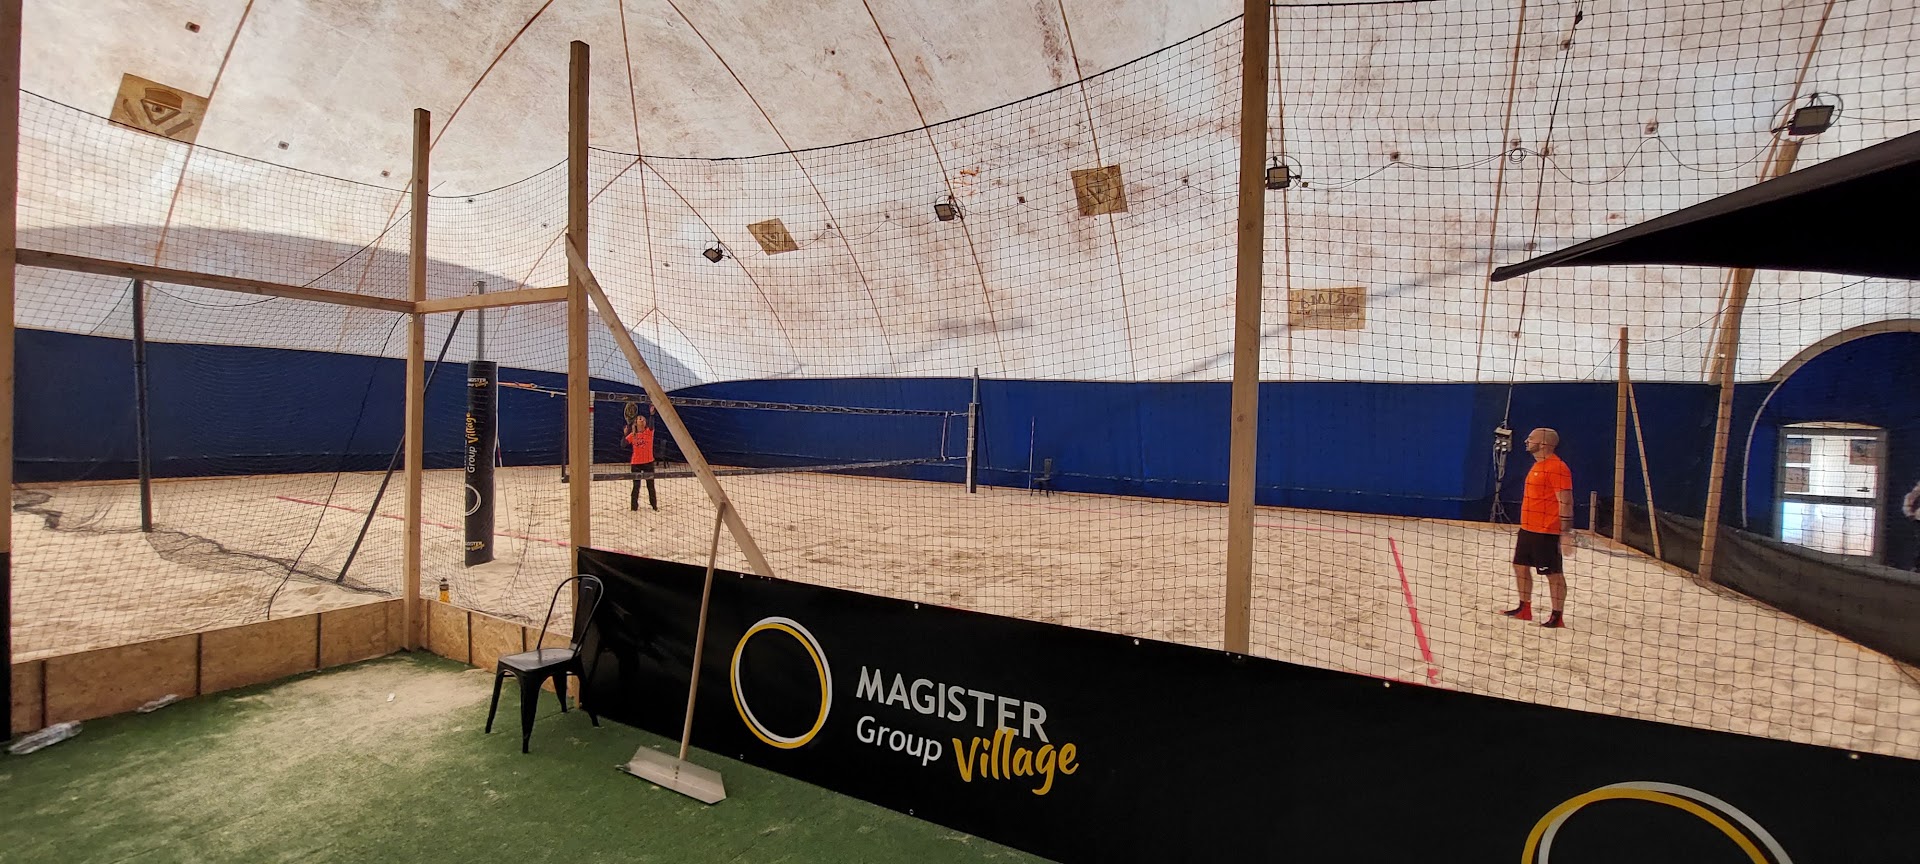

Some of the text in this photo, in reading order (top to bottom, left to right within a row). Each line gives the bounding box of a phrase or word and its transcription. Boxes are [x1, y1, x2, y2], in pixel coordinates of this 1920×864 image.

[467, 446, 477, 473] Group
[855, 666, 1049, 742] MAGISTER
[856, 716, 1080, 796] Group Village
